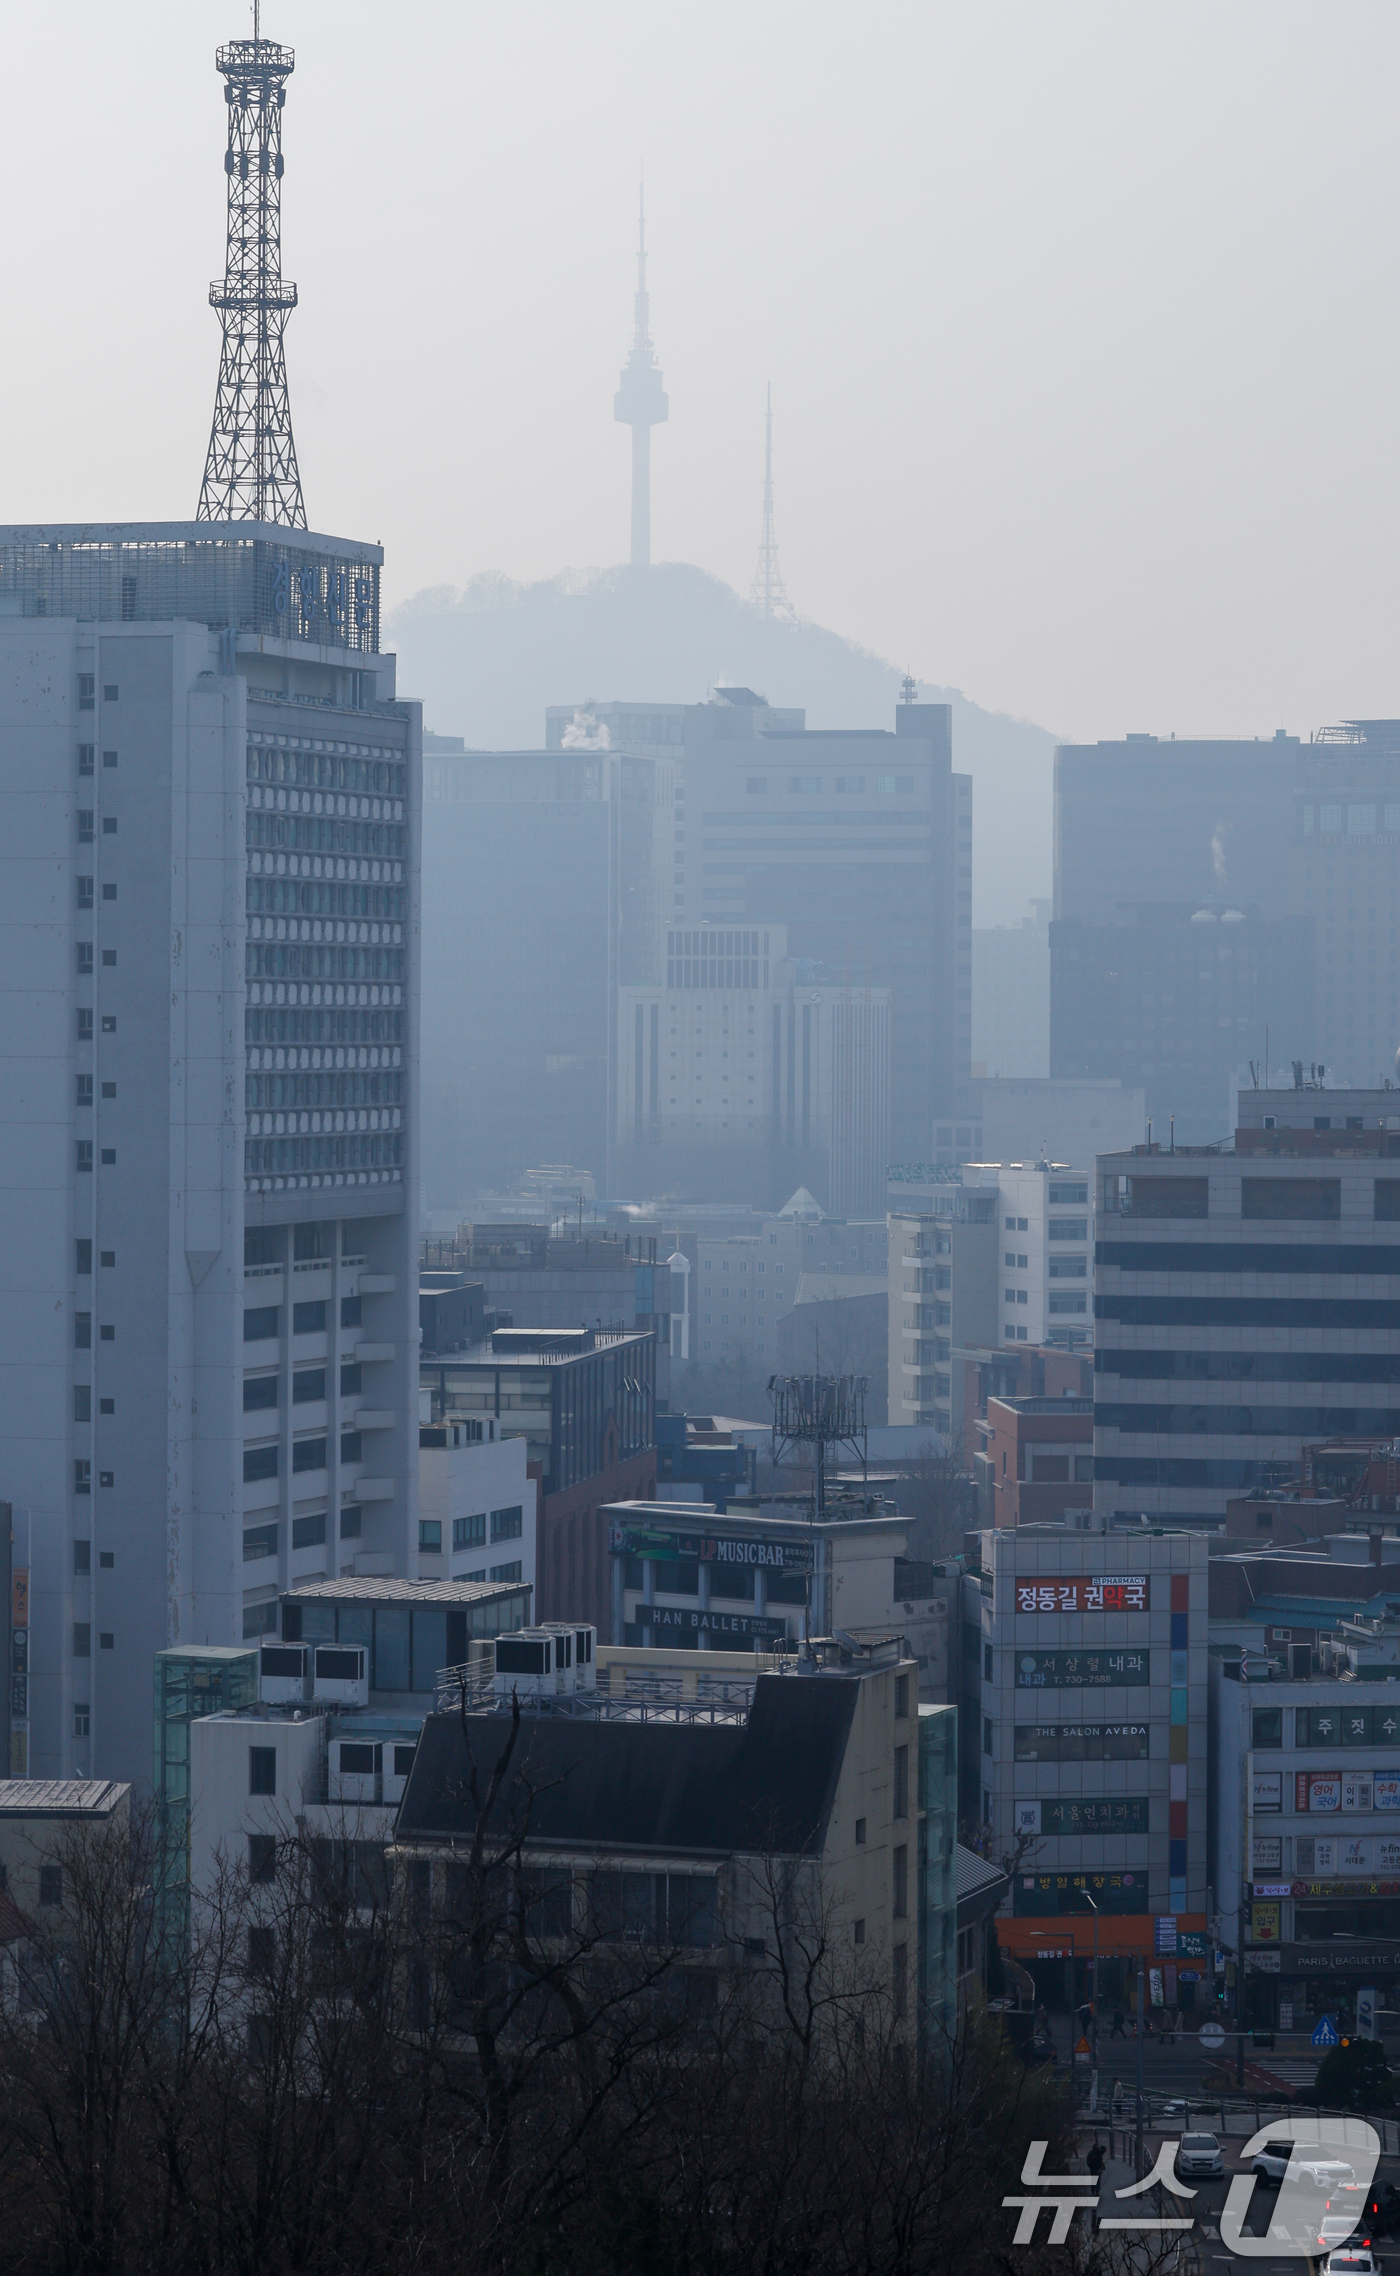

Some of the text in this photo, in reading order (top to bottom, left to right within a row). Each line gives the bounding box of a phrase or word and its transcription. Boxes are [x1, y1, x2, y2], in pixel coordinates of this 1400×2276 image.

[272, 560, 374, 628] 경향신문
[700, 1540, 717, 1560] LP
[1102, 1577, 1146, 1585] PHARMACY
[1018, 1586, 1078, 1611] 정동길
[1084, 1586, 1146, 1610] 권약국
[653, 1610, 748, 1632] HAN BALLET
[1109, 1655, 1143, 1671] 내과
[1019, 1673, 1046, 1686] 내과
[1065, 1675, 1111, 1684] 730-7588
[1036, 1727, 1147, 1737] THE SALON AVEDA
[1313, 1784, 1334, 1796] 영어
[1376, 1783, 1398, 1795] 수학
[1316, 1796, 1338, 1808] 국어
[1344, 1856, 1365, 1865] 서대문
[1293, 1883, 1307, 1895] 24
[1256, 1916, 1275, 1926] 입구
[1298, 1956, 1389, 1966] PARIS BAGUETTE
